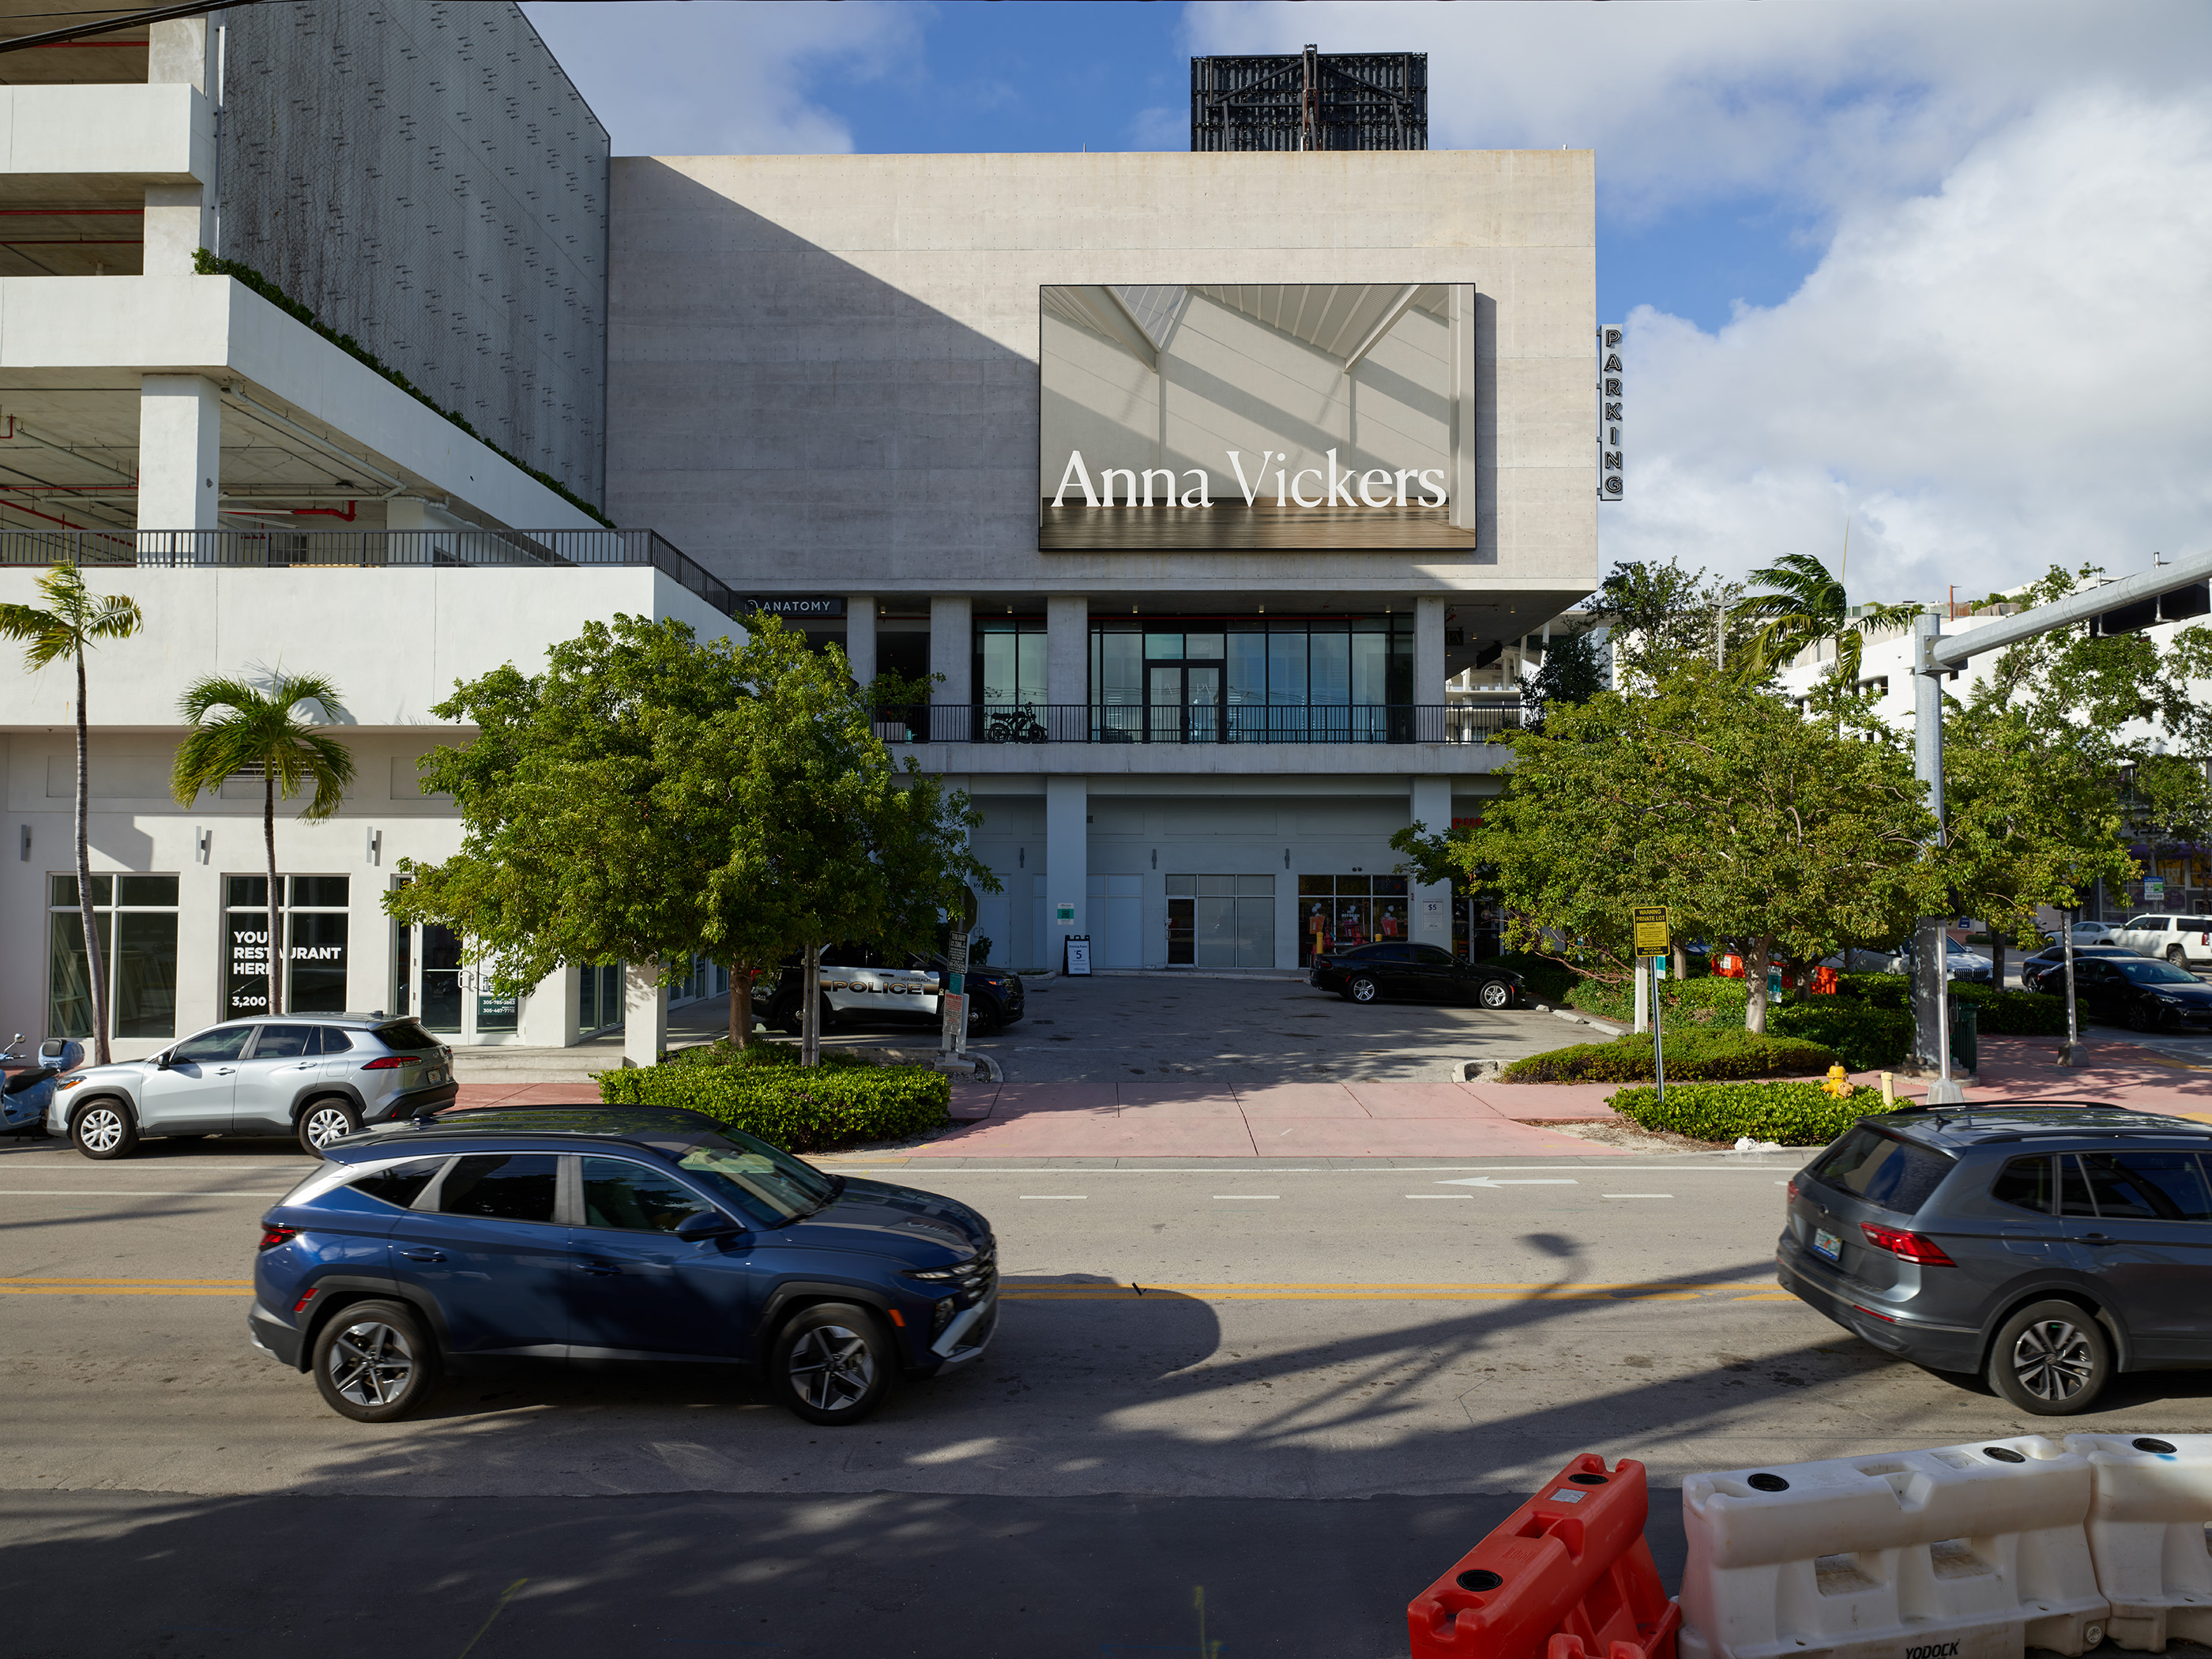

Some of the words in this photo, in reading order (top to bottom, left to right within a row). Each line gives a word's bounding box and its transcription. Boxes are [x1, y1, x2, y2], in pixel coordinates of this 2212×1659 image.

[1604, 329, 1623, 494] PARKING
[1051, 450, 1215, 509] Anna
[1226, 447, 1447, 509] Vickers
[762, 601, 831, 611] ANATOMY
[233, 931, 268, 943] YOU
[832, 980, 923, 995] POLICE
[231, 996, 267, 1008] 3,200
[1905, 1641, 1959, 1659] YODOCK
